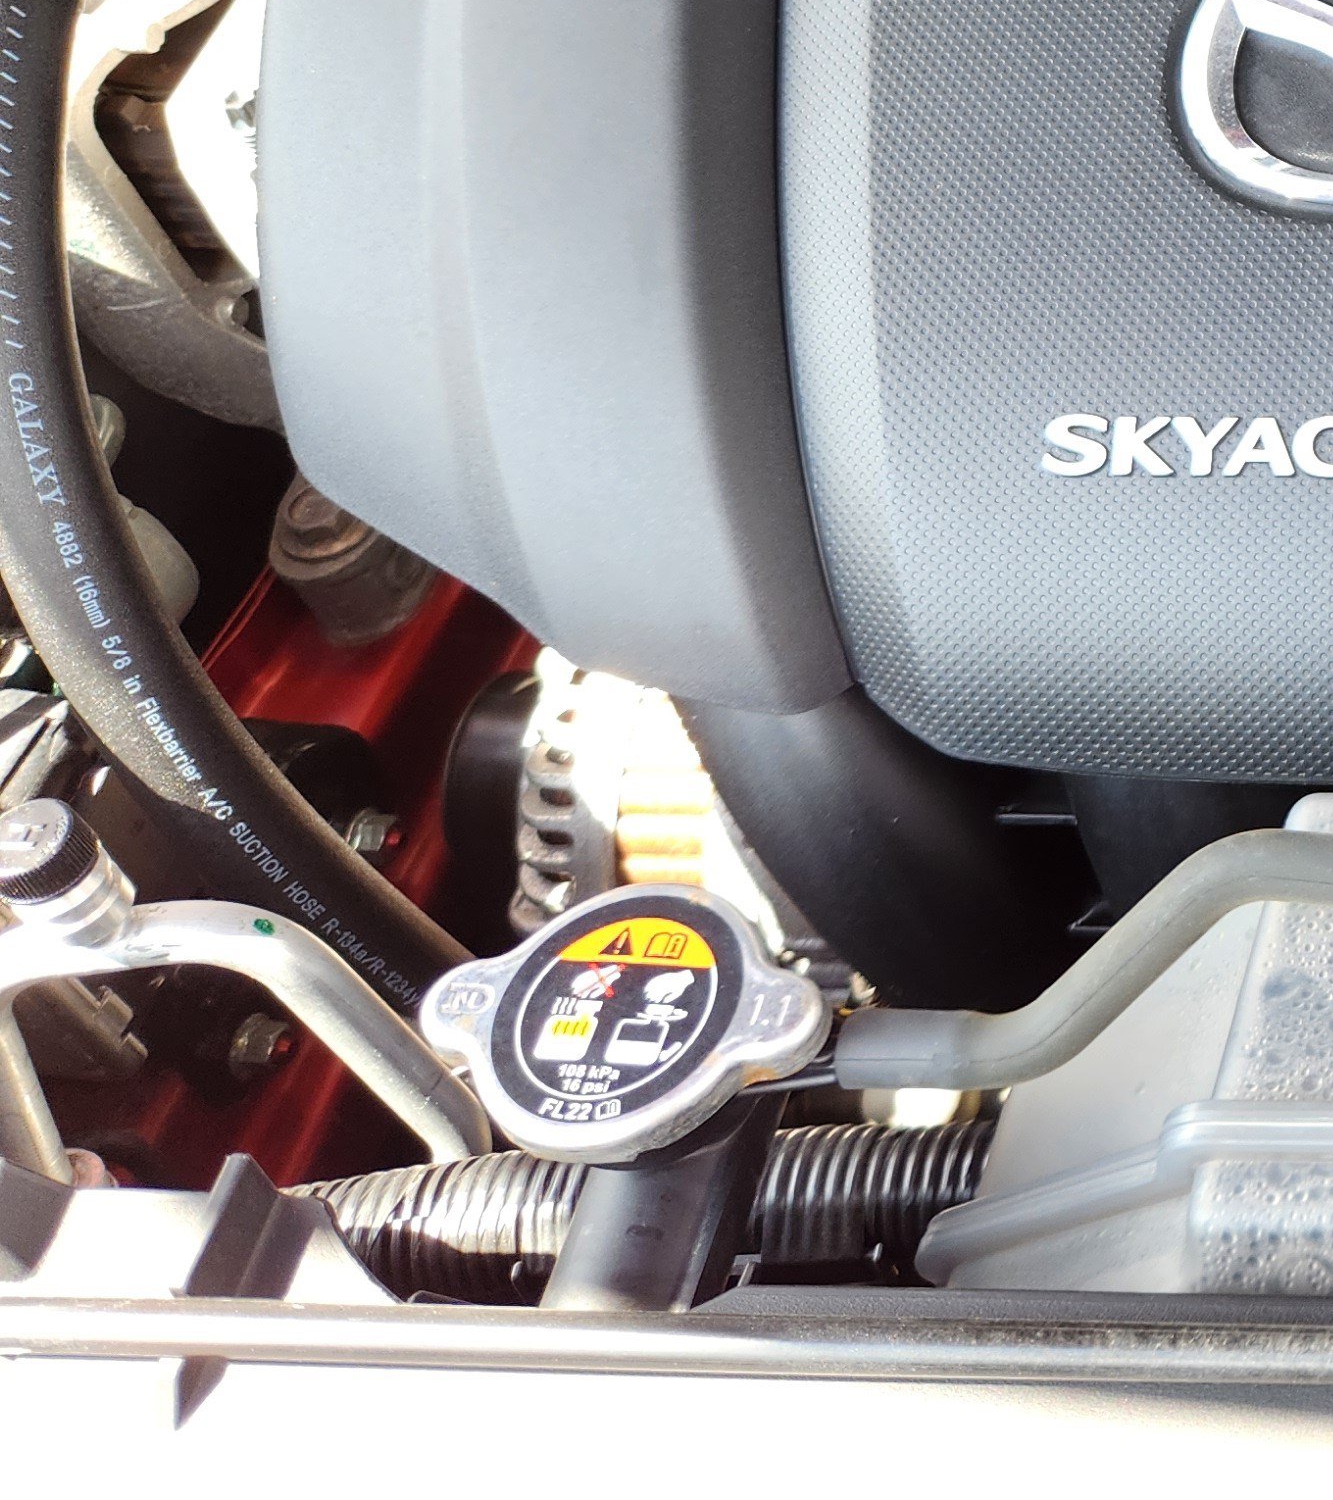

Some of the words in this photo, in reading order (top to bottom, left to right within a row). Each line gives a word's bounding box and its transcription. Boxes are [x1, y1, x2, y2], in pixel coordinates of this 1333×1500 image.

[9, 372, 66, 507] GALAXY
[52, 521, 83, 568] 4882
[72, 574, 111, 629] (16mm)
[101, 634, 133, 670] 5/8
[122, 674, 142, 695] in
[135, 696, 203, 783] Flexbarrier
[197, 787, 234, 821] A/C
[229, 821, 289, 883] SUCTION
[283, 880, 326, 920] HOSE
[750, 993, 792, 1027] 1.1
[558, 1063, 587, 1078] 108
[587, 1064, 621, 1081] kPa
[562, 1078, 582, 1092] 16
[581, 1080, 611, 1095] psi
[538, 1097, 593, 1120] FL22
